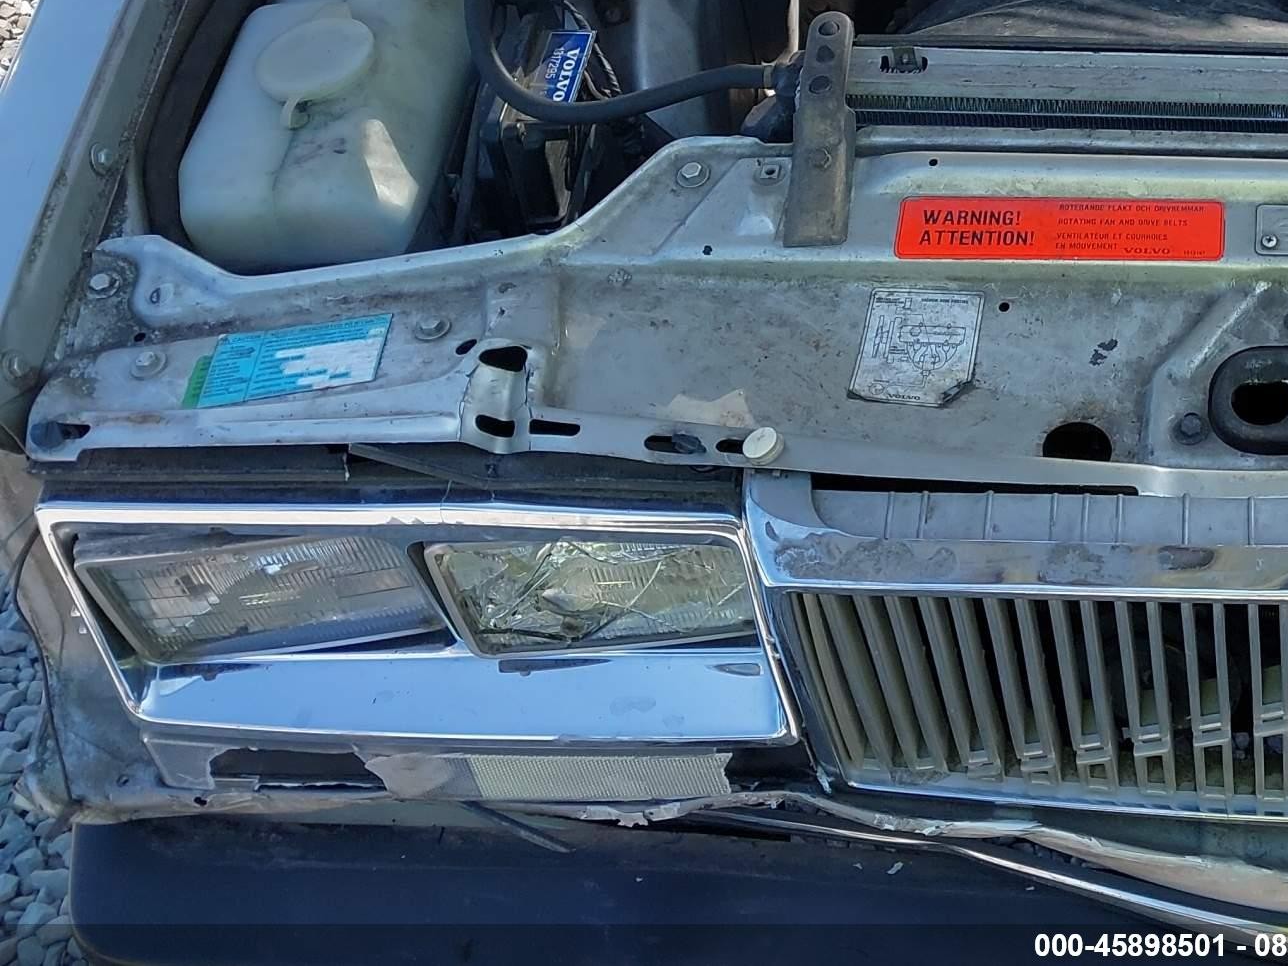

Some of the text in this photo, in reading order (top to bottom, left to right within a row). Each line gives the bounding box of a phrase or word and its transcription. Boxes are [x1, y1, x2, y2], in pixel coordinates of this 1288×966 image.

[553, 47, 581, 102] VOLVO
[1135, 205, 1151, 213] OCH
[923, 209, 1022, 226] WARNING!
[1057, 218, 1097, 226] ROTATING
[1099, 218, 1115, 226] FAN
[1138, 219, 1159, 227] DRIVE
[1163, 219, 1188, 227] BELTS
[919, 230, 1036, 246] ATTENTION!
[1056, 232, 1109, 241] VENTILATEUR
[1113, 233, 1122, 241] ET
[1055, 242, 1118, 251] EN MOUVEMENT
[1123, 246, 1171, 255] VOLVO
[888, 393, 921, 401] VOLVO
